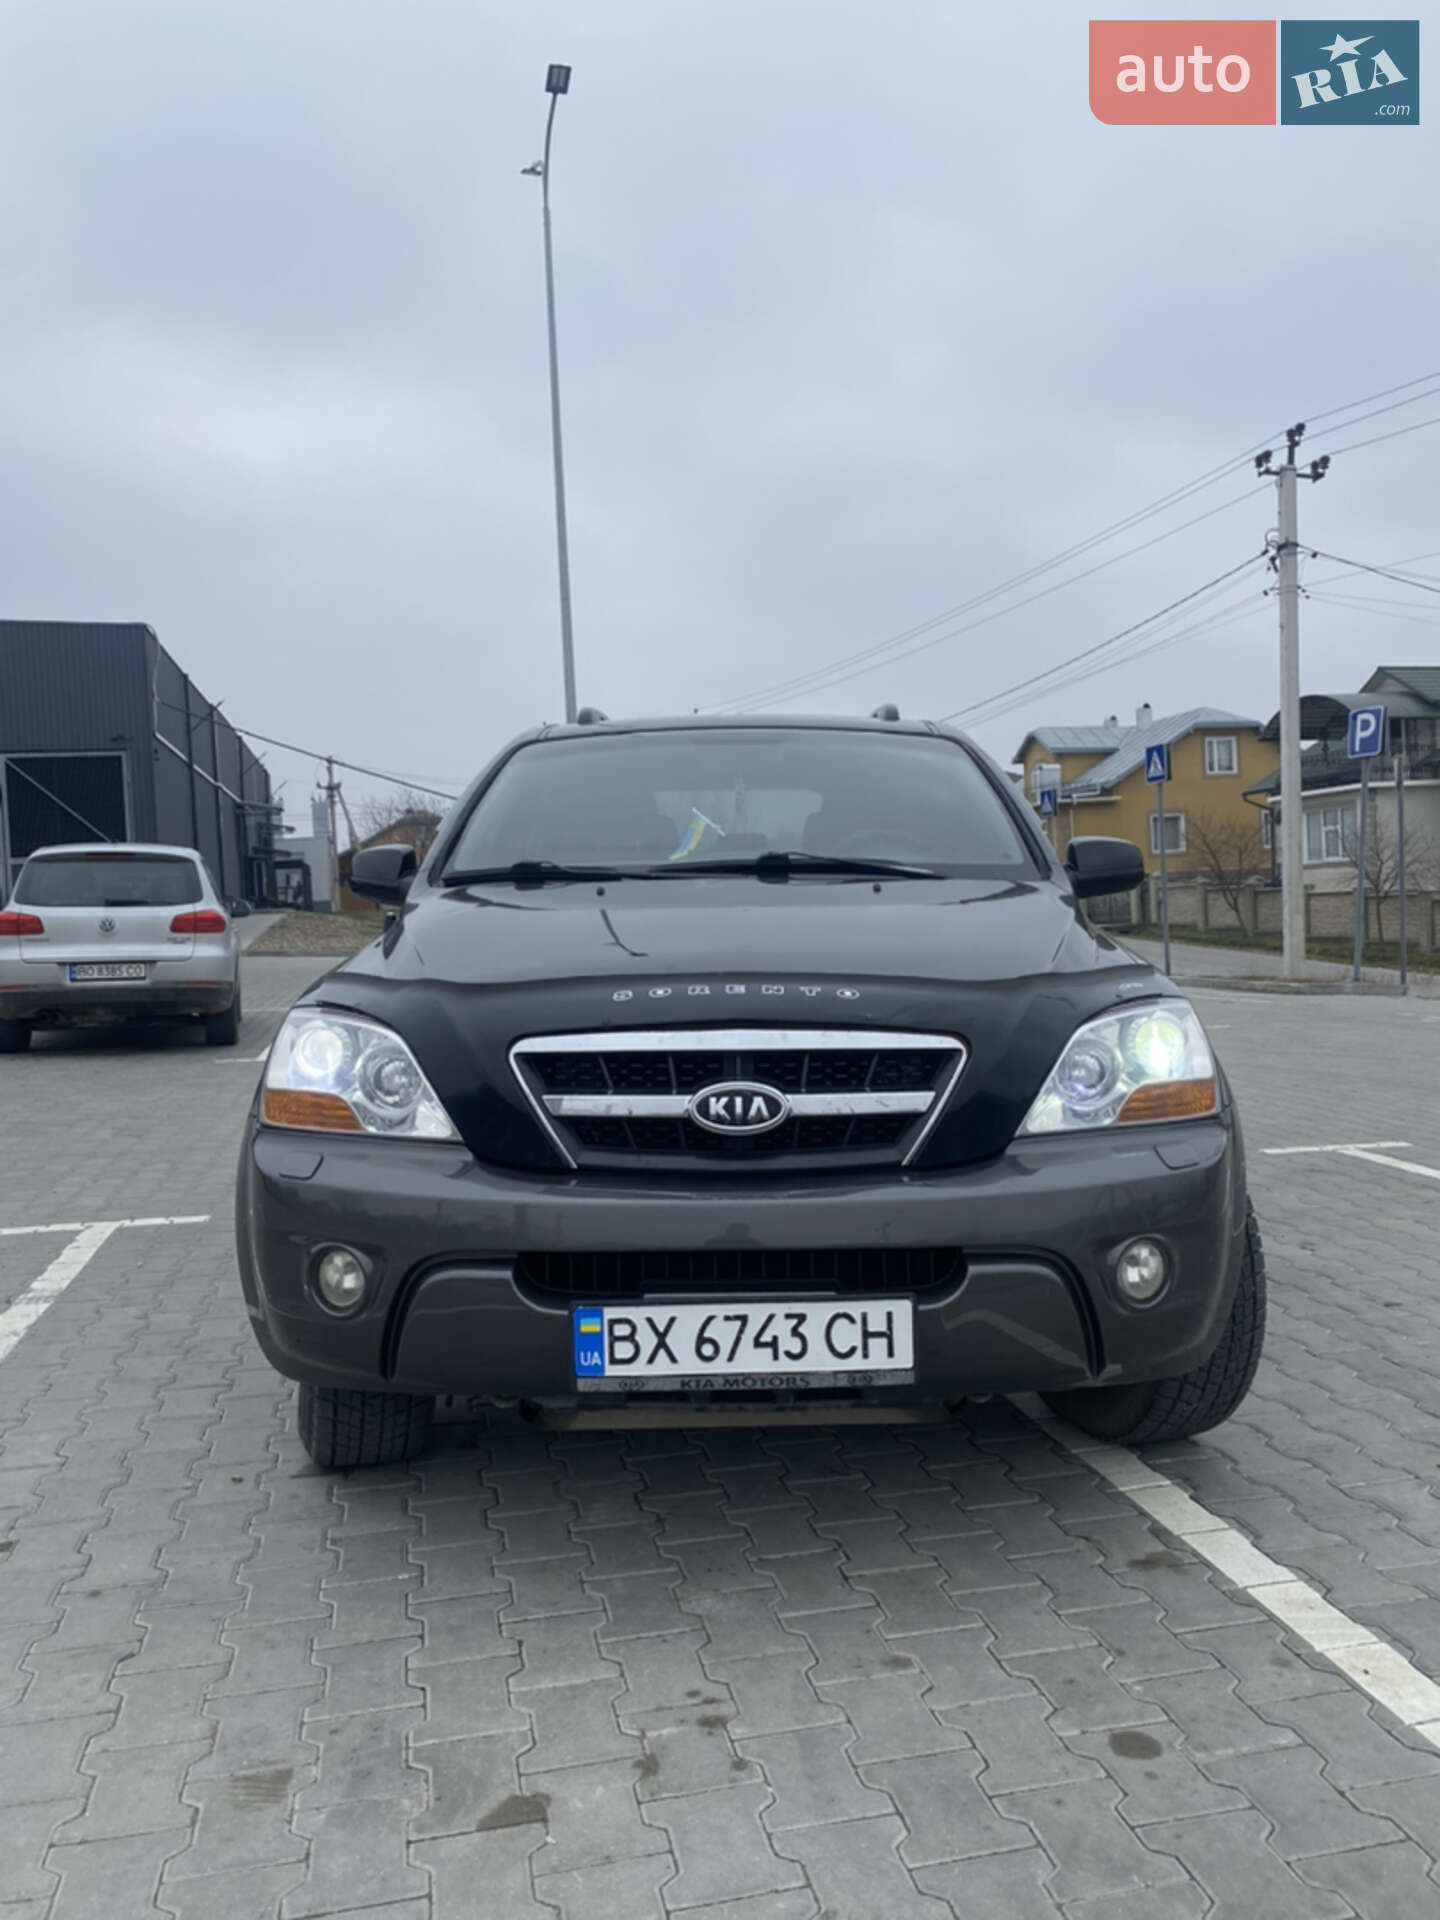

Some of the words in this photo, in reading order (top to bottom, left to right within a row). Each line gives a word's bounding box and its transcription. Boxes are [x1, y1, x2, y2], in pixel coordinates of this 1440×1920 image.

[1355, 712, 1376, 752] P
[612, 984, 860, 1001] SORENTO
[708, 1096, 769, 1121] KIA
[607, 1316, 679, 1366] BX
[694, 1313, 809, 1363] 6743
[824, 1310, 895, 1360] CH
[580, 1351, 602, 1366] UA
[680, 1378, 715, 1390] KIA
[723, 1375, 811, 1389] MOTORS
